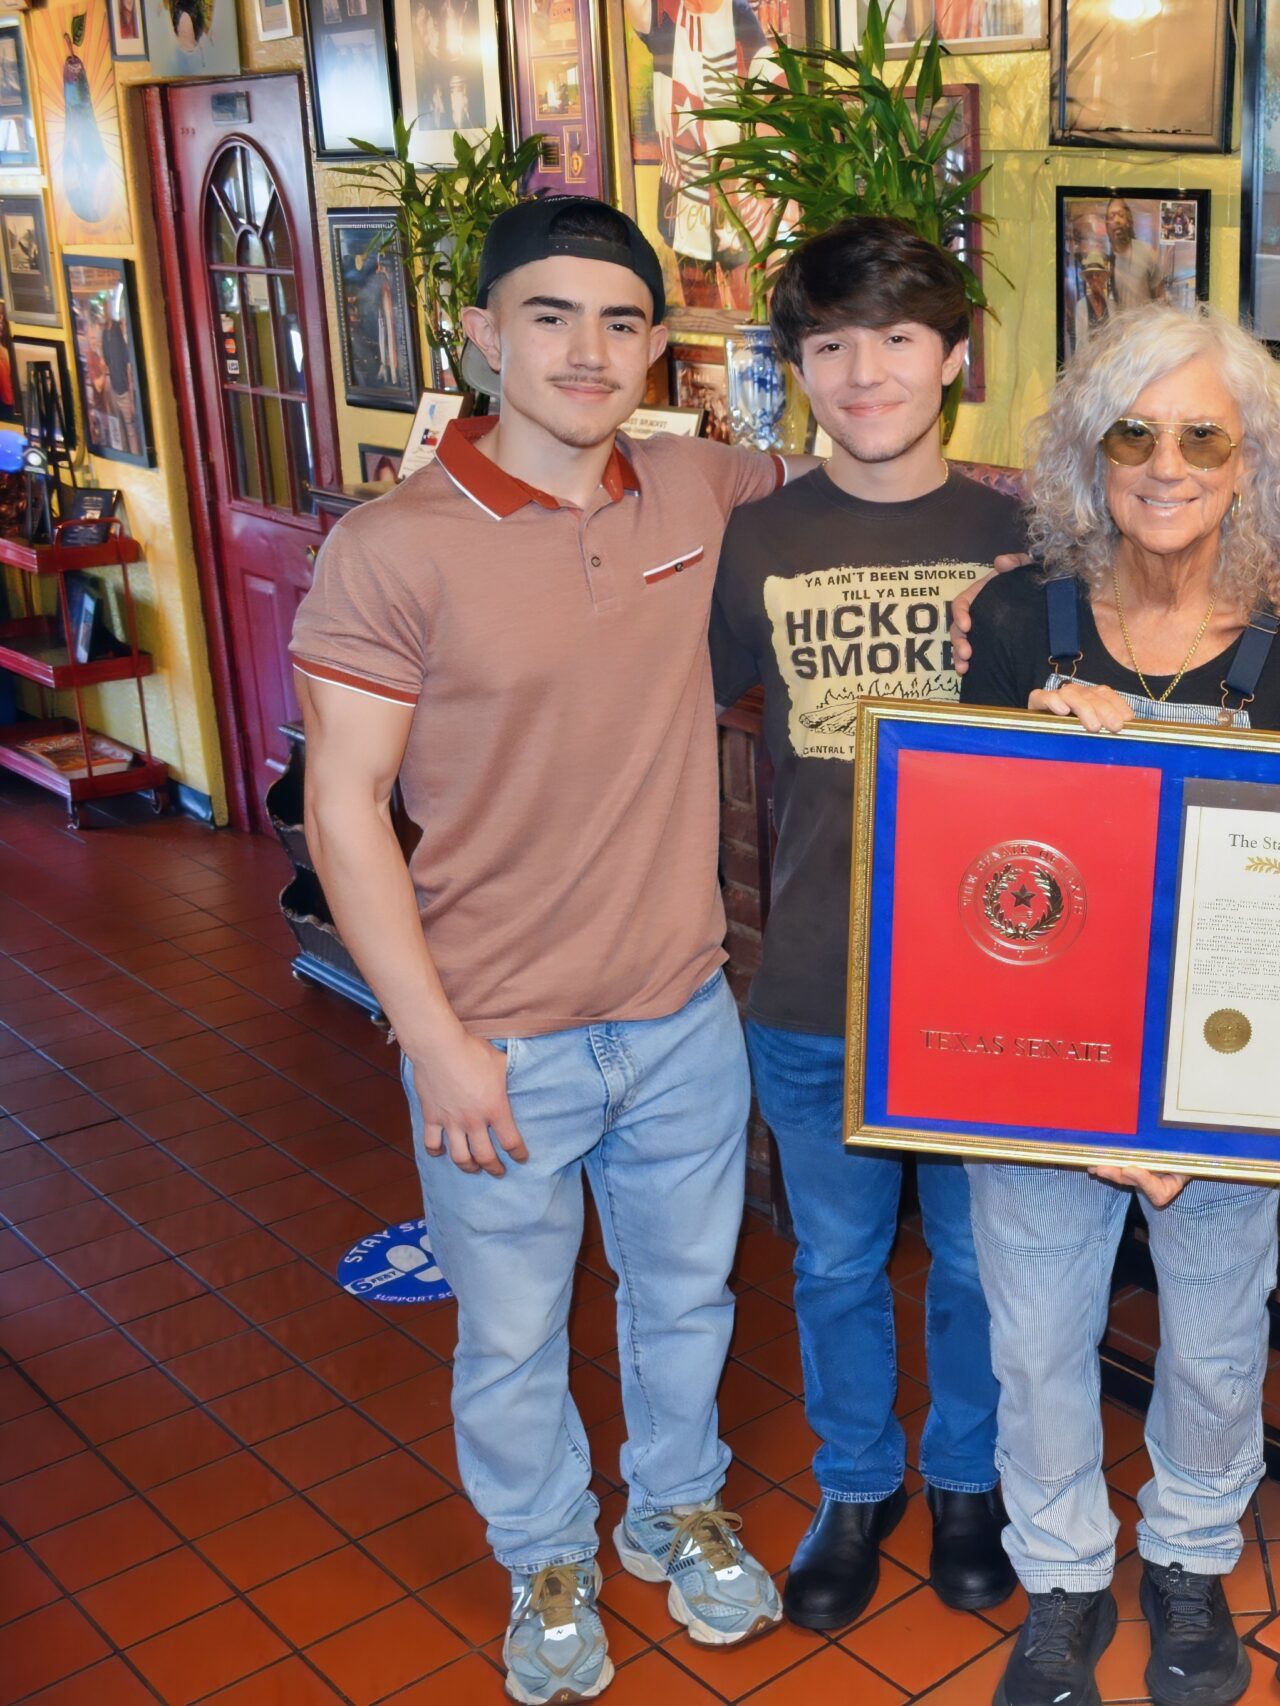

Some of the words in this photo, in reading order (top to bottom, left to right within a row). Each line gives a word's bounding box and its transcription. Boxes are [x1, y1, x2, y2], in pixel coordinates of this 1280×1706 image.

[805, 578, 822, 588] YA
[827, 571, 865, 585] AIN'T
[869, 570, 910, 582] BEEN
[914, 569, 977, 581] SMOKED
[842, 590, 871, 601] TILL
[876, 588, 896, 599] YA
[900, 586, 940, 598] BEEN
[785, 600, 955, 646] HICKO
[791, 637, 957, 680] SMOKE
[802, 745, 846, 755] CENTRAL
[1228, 833, 1258, 849] The
[920, 1029, 1004, 1054] TEXAS
[1013, 1037, 1112, 1063] SENATE
[344, 1229, 391, 1263] STAY
[374, 1292, 434, 1303] SUPPORT
